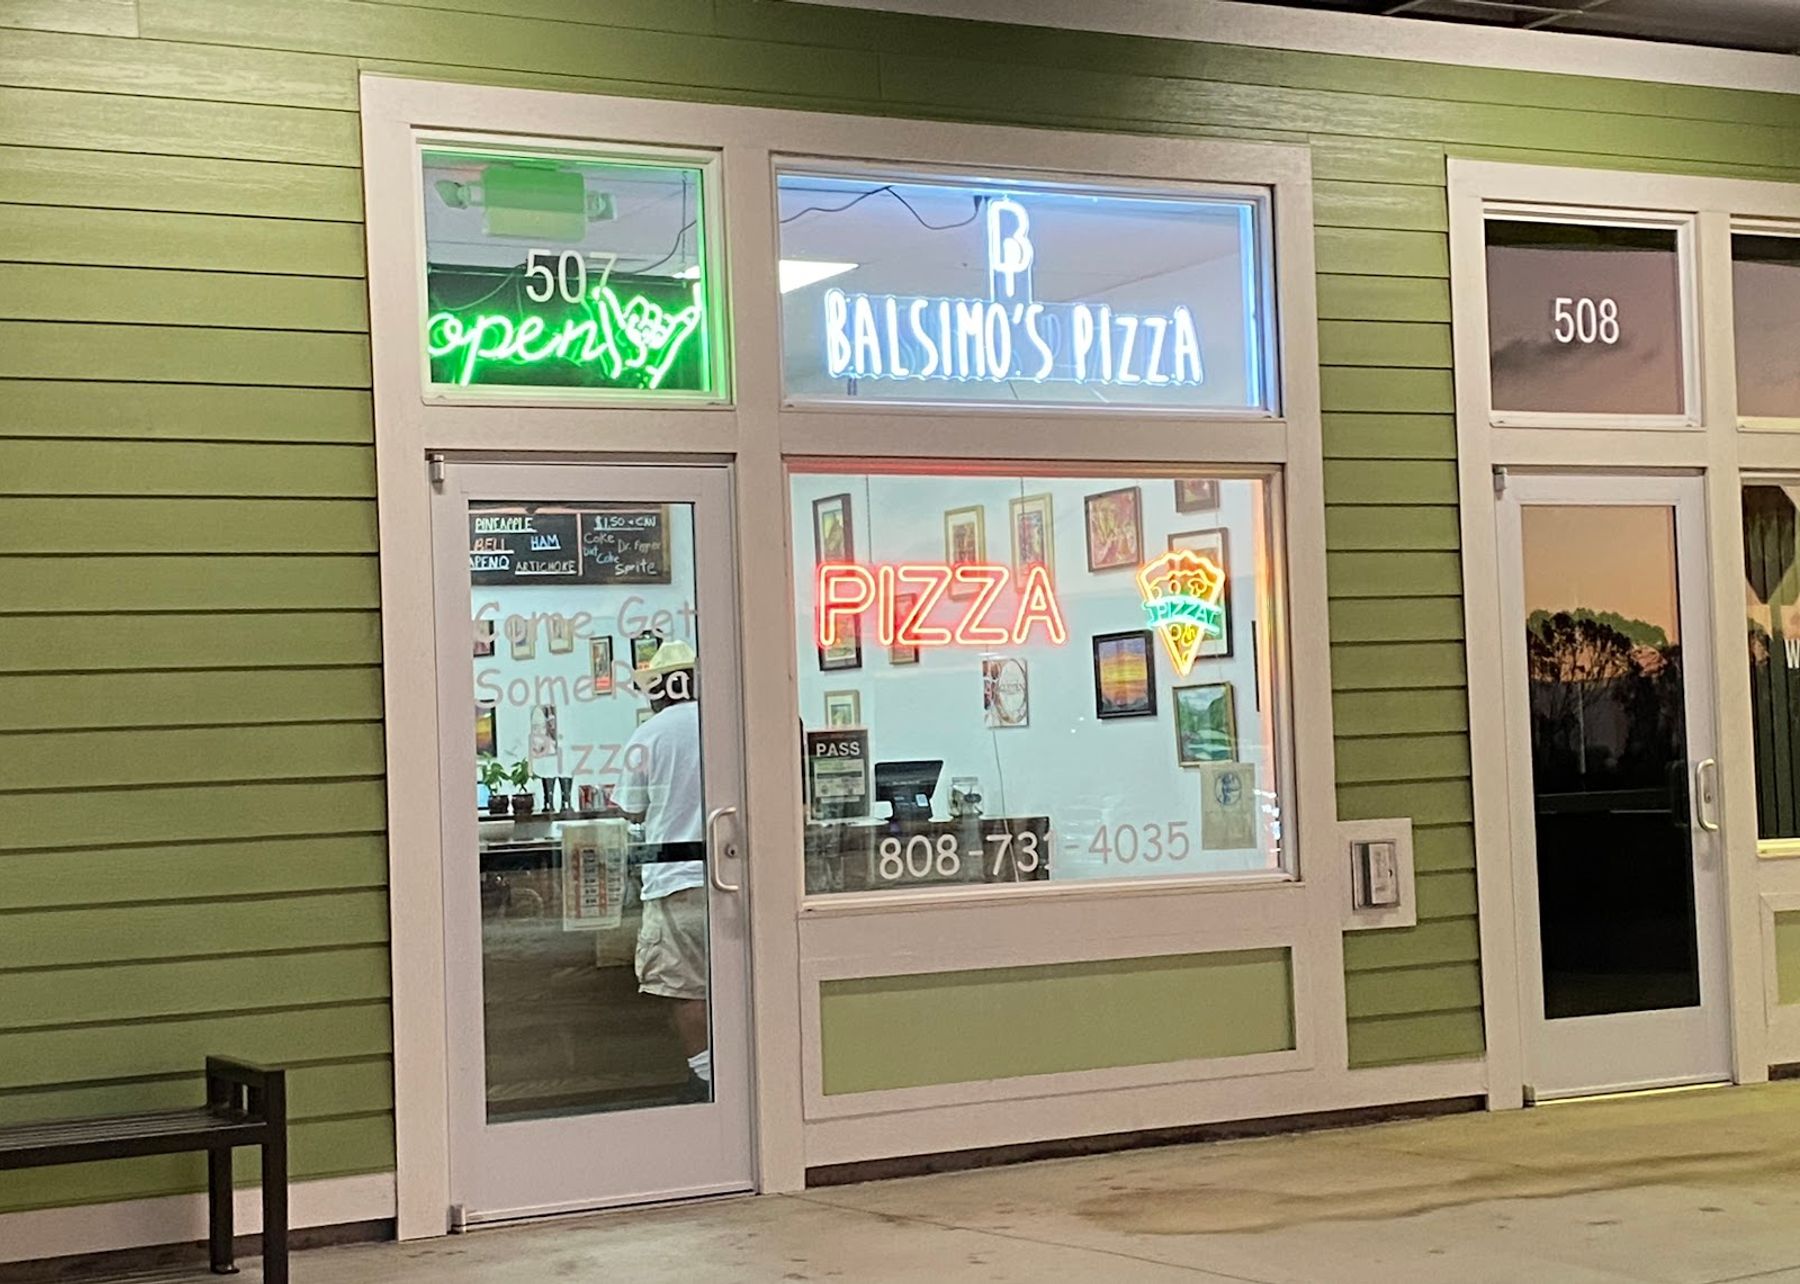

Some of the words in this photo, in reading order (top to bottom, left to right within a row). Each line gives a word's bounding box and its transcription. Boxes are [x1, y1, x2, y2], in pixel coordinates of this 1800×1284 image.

[525, 248, 618, 304] 507
[1554, 297, 1620, 344] 508
[825, 289, 1053, 382] BALSIMO'S
[1073, 302, 1202, 385] PIZZA
[425, 312, 606, 387] open
[474, 517, 534, 532] PINEAPPLE
[472, 537, 506, 551] BELL
[530, 534, 561, 549] HAM
[583, 532, 616, 545] Coke
[617, 539, 632, 553] Dr.
[514, 560, 577, 572] ARTICHOKE
[614, 558, 657, 575] Sprite
[816, 564, 1068, 646] PIZZA
[1158, 600, 1208, 621] PIZZA
[474, 602, 595, 644] Come
[616, 596, 698, 640] Get
[476, 668, 600, 708] Some
[816, 742, 861, 757] PASS
